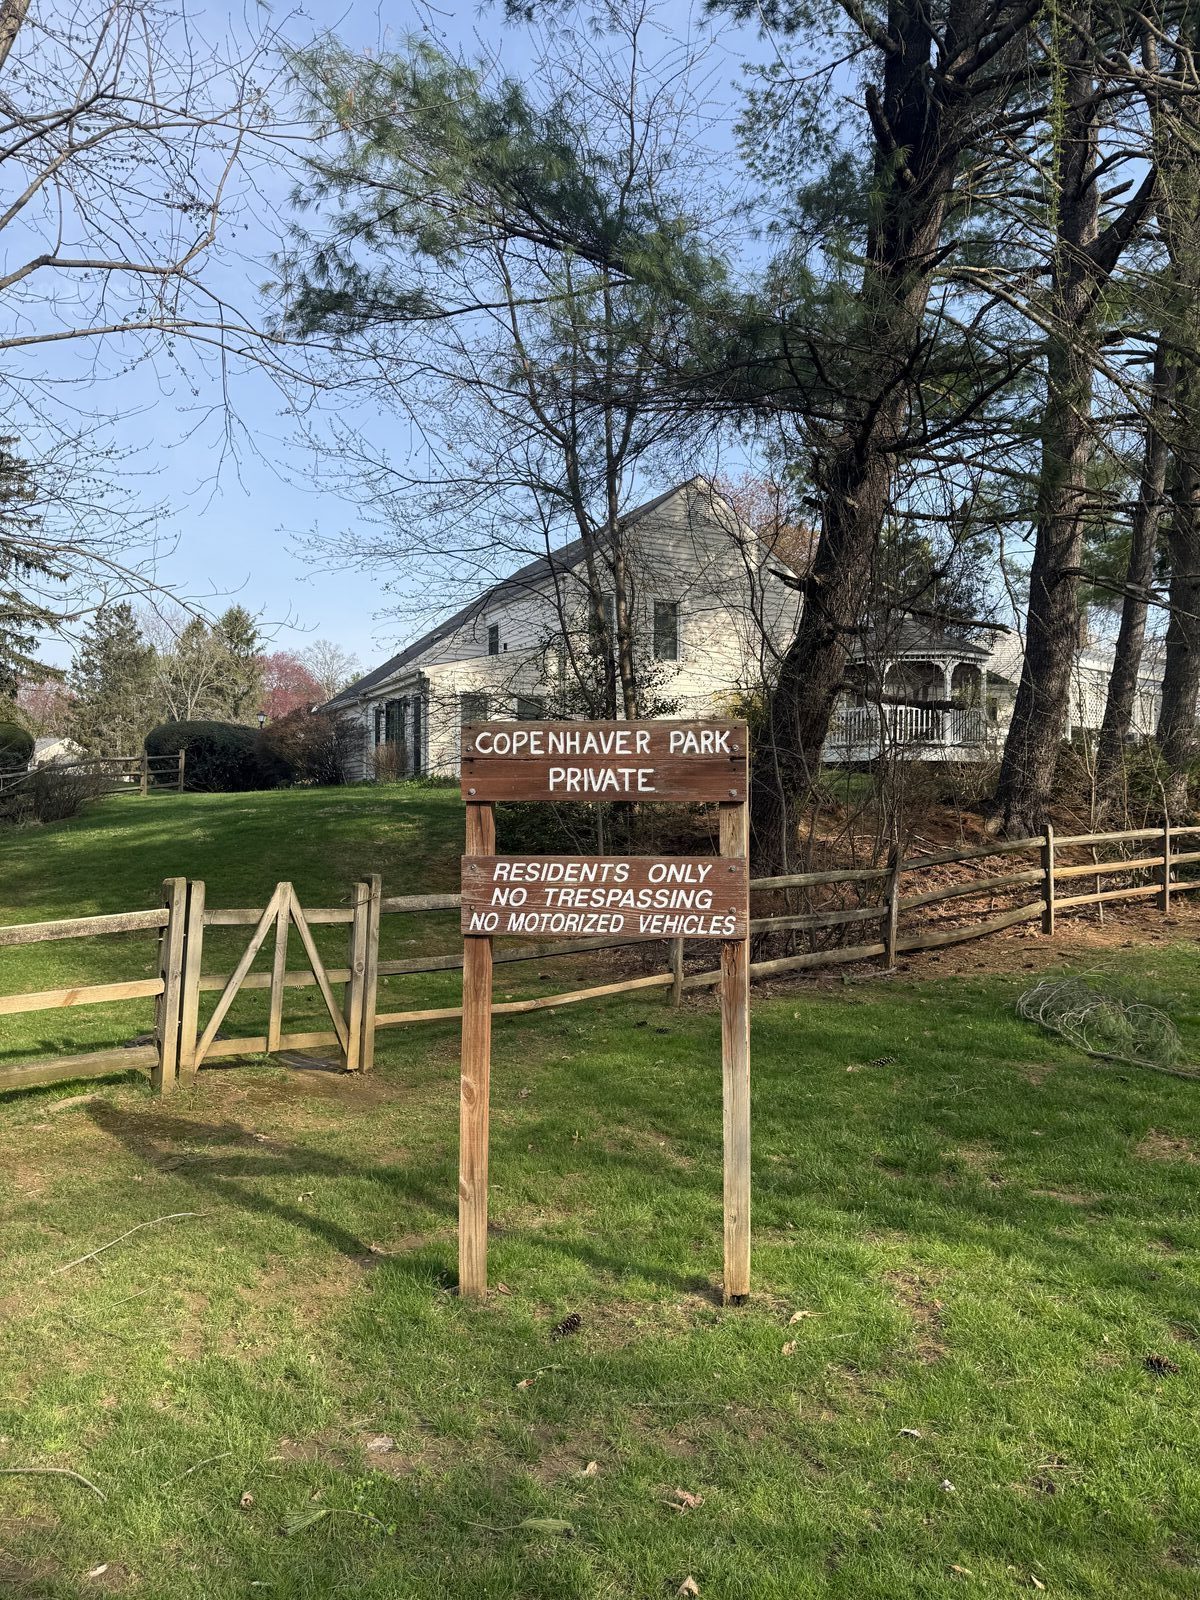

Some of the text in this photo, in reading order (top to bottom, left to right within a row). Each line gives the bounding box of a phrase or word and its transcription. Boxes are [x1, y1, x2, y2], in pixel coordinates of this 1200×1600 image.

[475, 730, 731, 755] COPENHAVER PARK
[549, 767, 656, 792] PRIVATE
[493, 863, 713, 883] RESIDENTS ONLY
[491, 887, 713, 909] NO TRESPASSING
[469, 912, 737, 935] NO MOTORIZED VEHICLES
